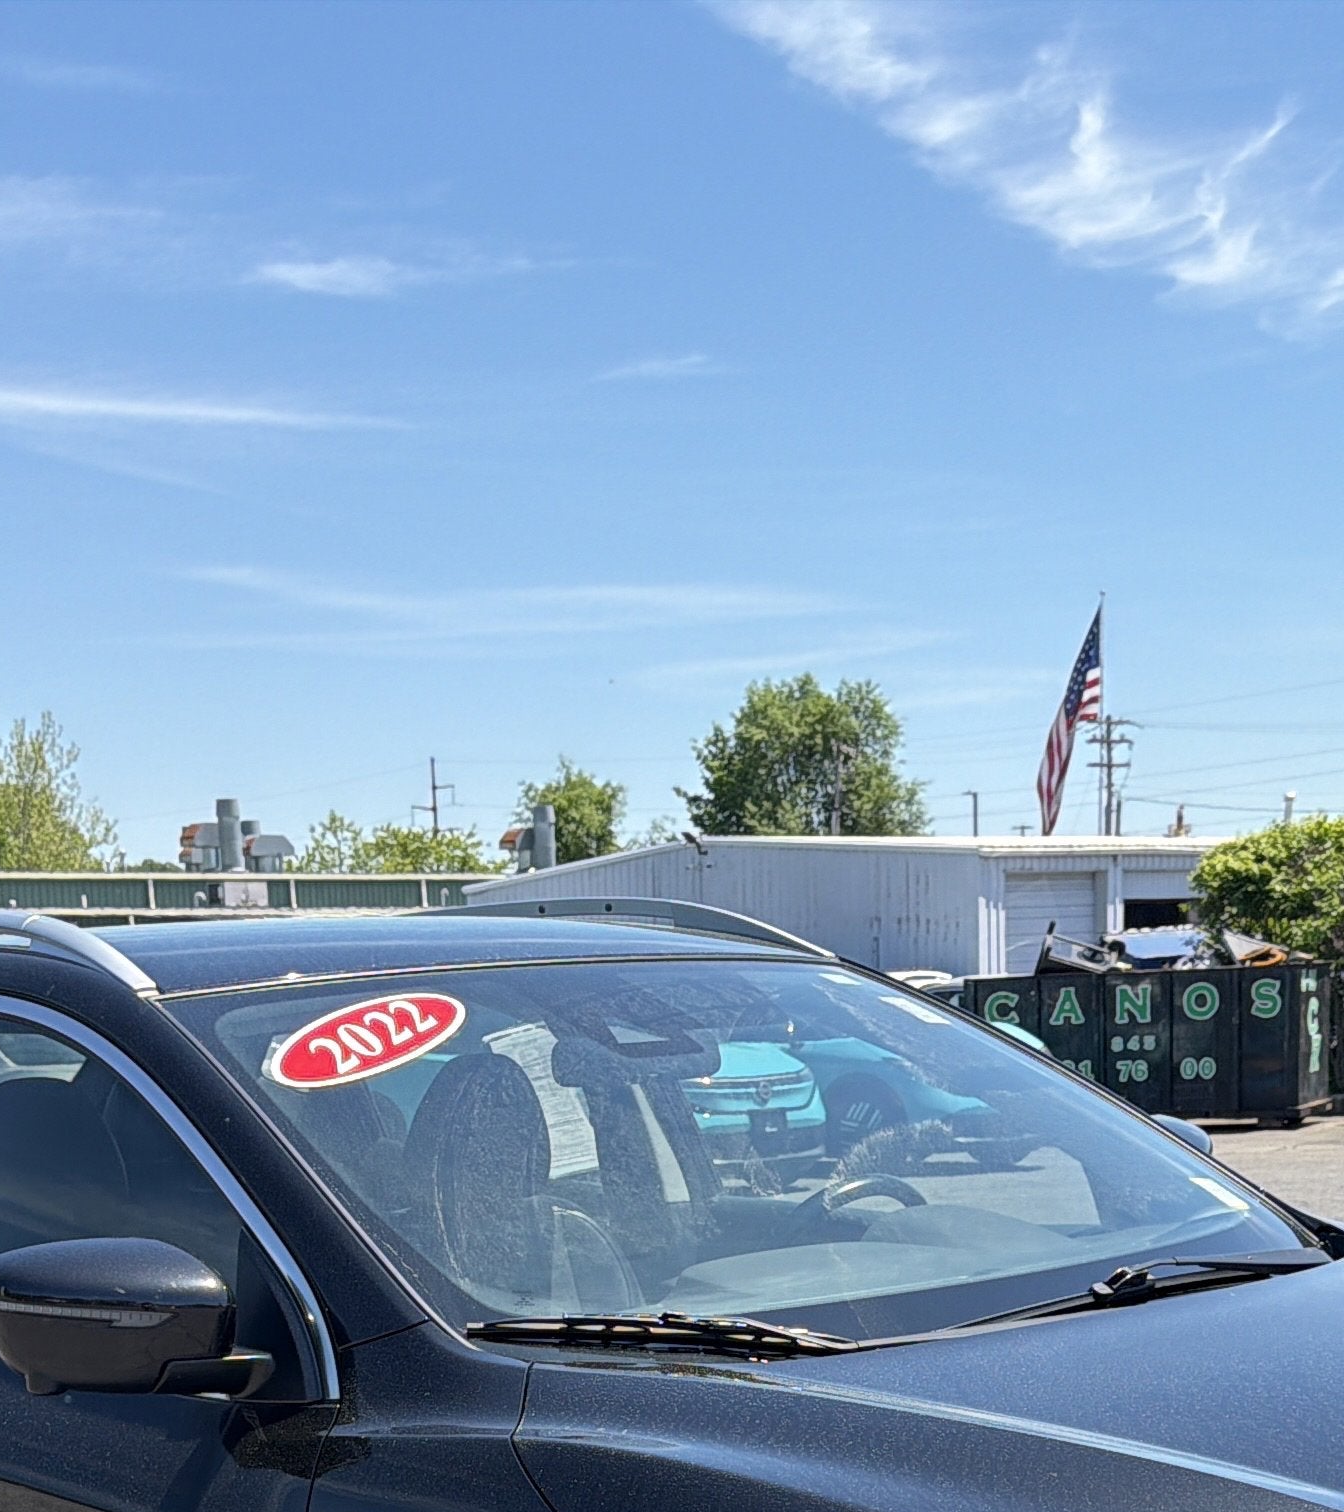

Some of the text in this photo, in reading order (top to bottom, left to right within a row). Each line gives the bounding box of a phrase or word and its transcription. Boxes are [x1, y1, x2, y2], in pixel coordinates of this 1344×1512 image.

[308, 1000, 439, 1074] 2022
[1116, 1060, 1148, 1082] 76
[1180, 1057, 1216, 1080] 00
